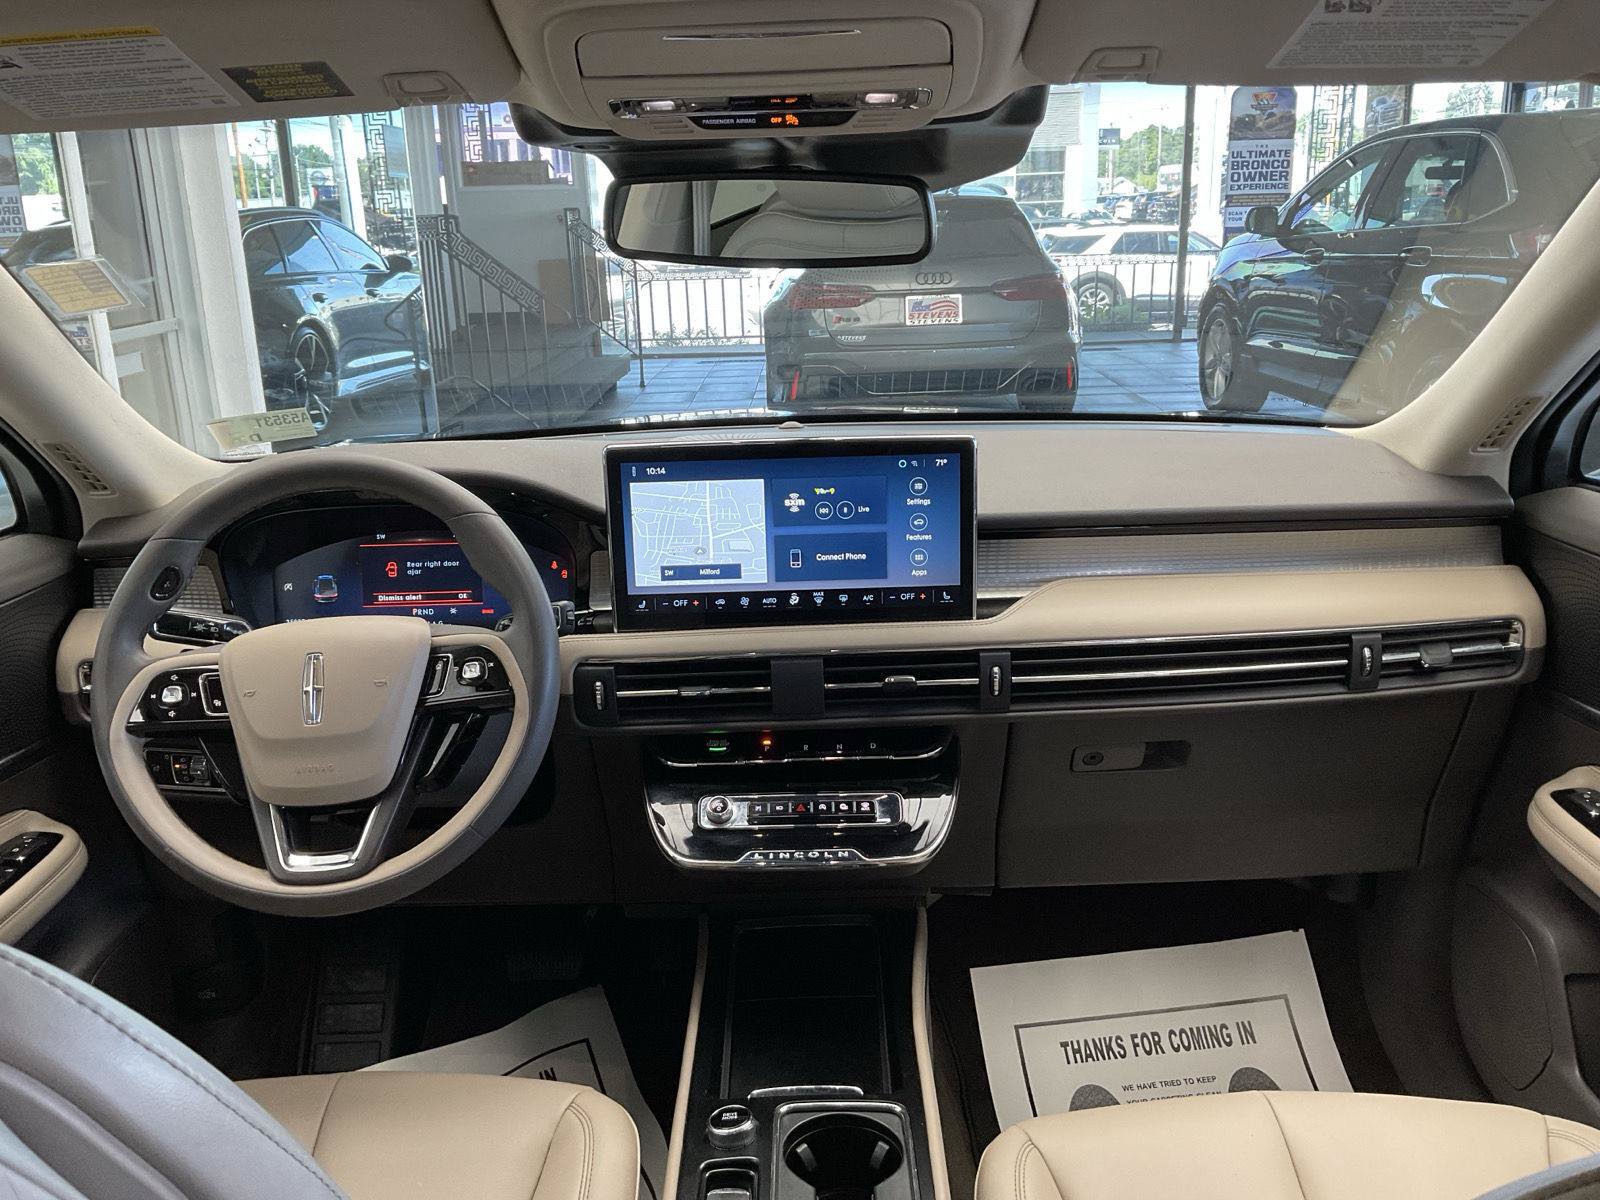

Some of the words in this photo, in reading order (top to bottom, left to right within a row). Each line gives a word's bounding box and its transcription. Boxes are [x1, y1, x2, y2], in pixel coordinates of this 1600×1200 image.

[1231, 149, 1291, 159] ULTIMATE
[1230, 159, 1291, 171] BRONCO
[1230, 170, 1289, 183] OWNER
[1229, 182, 1289, 192] EXPERIENCE
[907, 310, 959, 320] STEVENS
[646, 467, 666, 475] 10:14
[906, 498, 931, 506] Settings
[906, 533, 933, 541] Features
[816, 553, 844, 561] Connect
[845, 552, 867, 560] Phone
[423, 560, 441, 570] right
[406, 568, 422, 577] ajar
[699, 568, 721, 576] Milford
[911, 569, 928, 577] Apps
[900, 593, 916, 601] OFF
[673, 599, 689, 607] OFF
[750, 850, 850, 860] LINCOLN
[1060, 1034, 1127, 1065] THANKS
[1130, 1031, 1165, 1058] FOR
[1168, 1023, 1233, 1053] COMING
[1236, 1020, 1257, 1046] IN
[1121, 1083, 1136, 1092] WE
[1136, 1081, 1158, 1091] HAVE
[1159, 1079, 1182, 1089] TRIED
[1183, 1077, 1195, 1086] TO
[1196, 1075, 1217, 1084] KEEP
